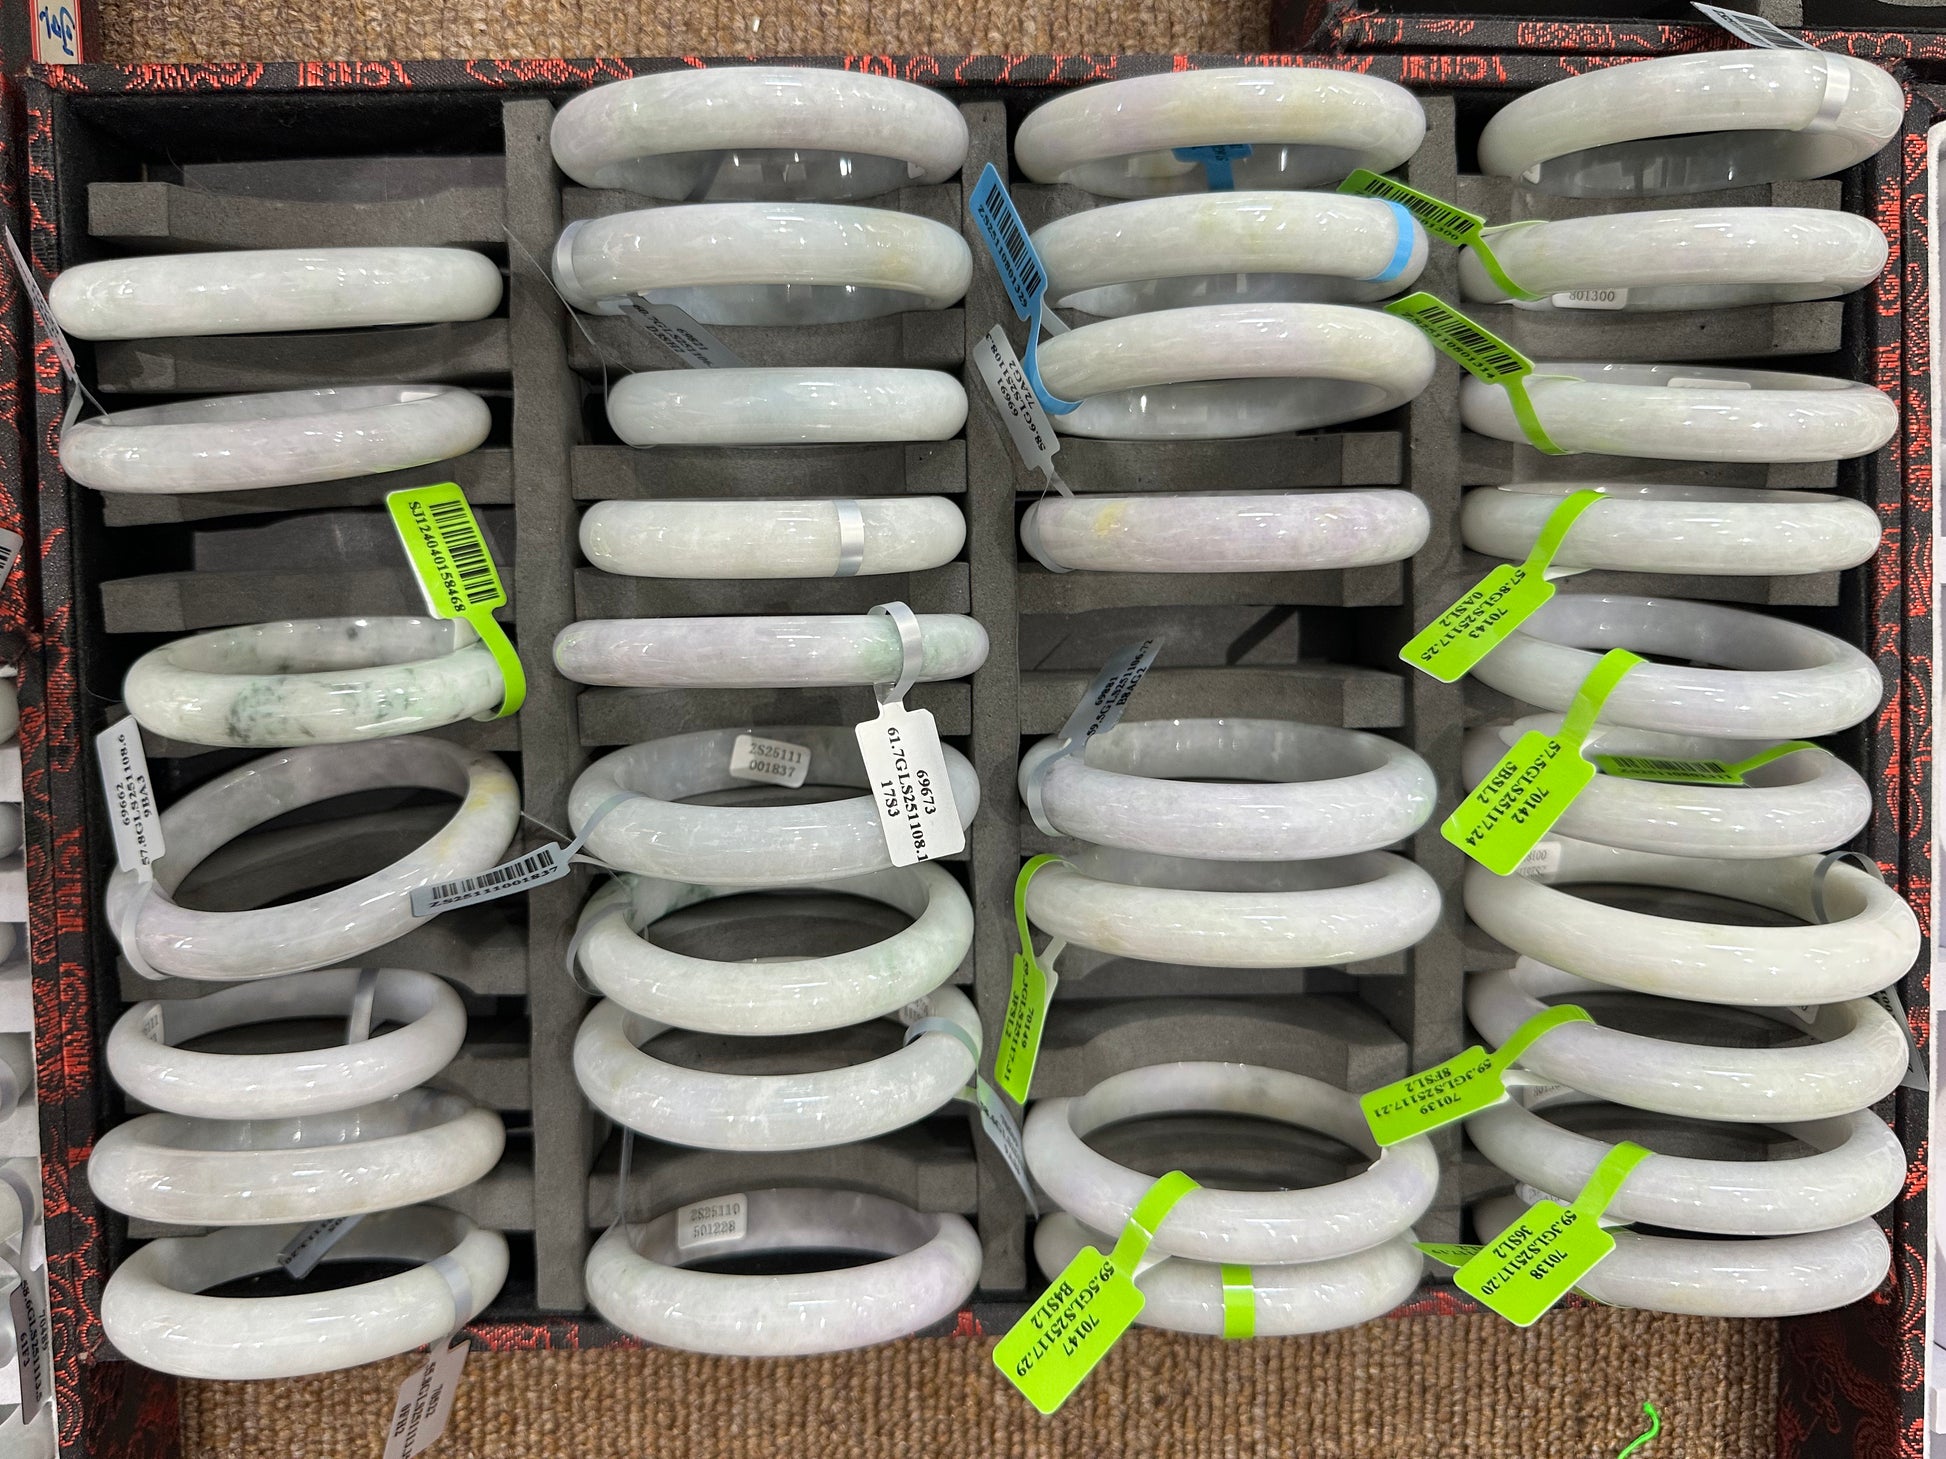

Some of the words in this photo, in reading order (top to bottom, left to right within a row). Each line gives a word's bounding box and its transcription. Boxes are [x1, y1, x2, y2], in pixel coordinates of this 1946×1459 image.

[978, 205, 1027, 307] ZS25110801329
[996, 378, 1019, 416] 69691
[1008, 360, 1035, 409] 72AG2
[408, 501, 466, 612] SJ124040158468
[1421, 569, 1526, 661] 57.8GLS25117.25
[1439, 592, 1483, 627] 0ASL2
[1469, 608, 1508, 638] 70143
[749, 760, 795, 777] 001837
[1477, 761, 1518, 804] 5BSL2
[115, 783, 130, 826] 69662
[118, 734, 150, 865] 57.8GLS251108.6
[136, 775, 151, 818] 9BA3
[880, 780, 900, 817] 17S3
[888, 727, 928, 861] 61.7GLS251108.1
[915, 770, 936, 814] 69673
[1465, 741, 1561, 846] 57.5GLS25117.24
[1511, 787, 1549, 823] 70142
[1021, 1008, 1034, 1048] 70149
[1374, 1059, 1492, 1117] 59.3GLS25117.21
[1405, 1068, 1451, 1092] 8FSL2
[1420, 1093, 1461, 1114] 70139
[1481, 1210, 1577, 1295] 59.3GLS25117.20
[1492, 1225, 1533, 1258] 36SL2
[1530, 1249, 1568, 1280] 70138
[1017, 1261, 1114, 1376] 59.5GLS25117.29
[1031, 1281, 1074, 1329] B4SL2
[1063, 1314, 1100, 1356] 70147
